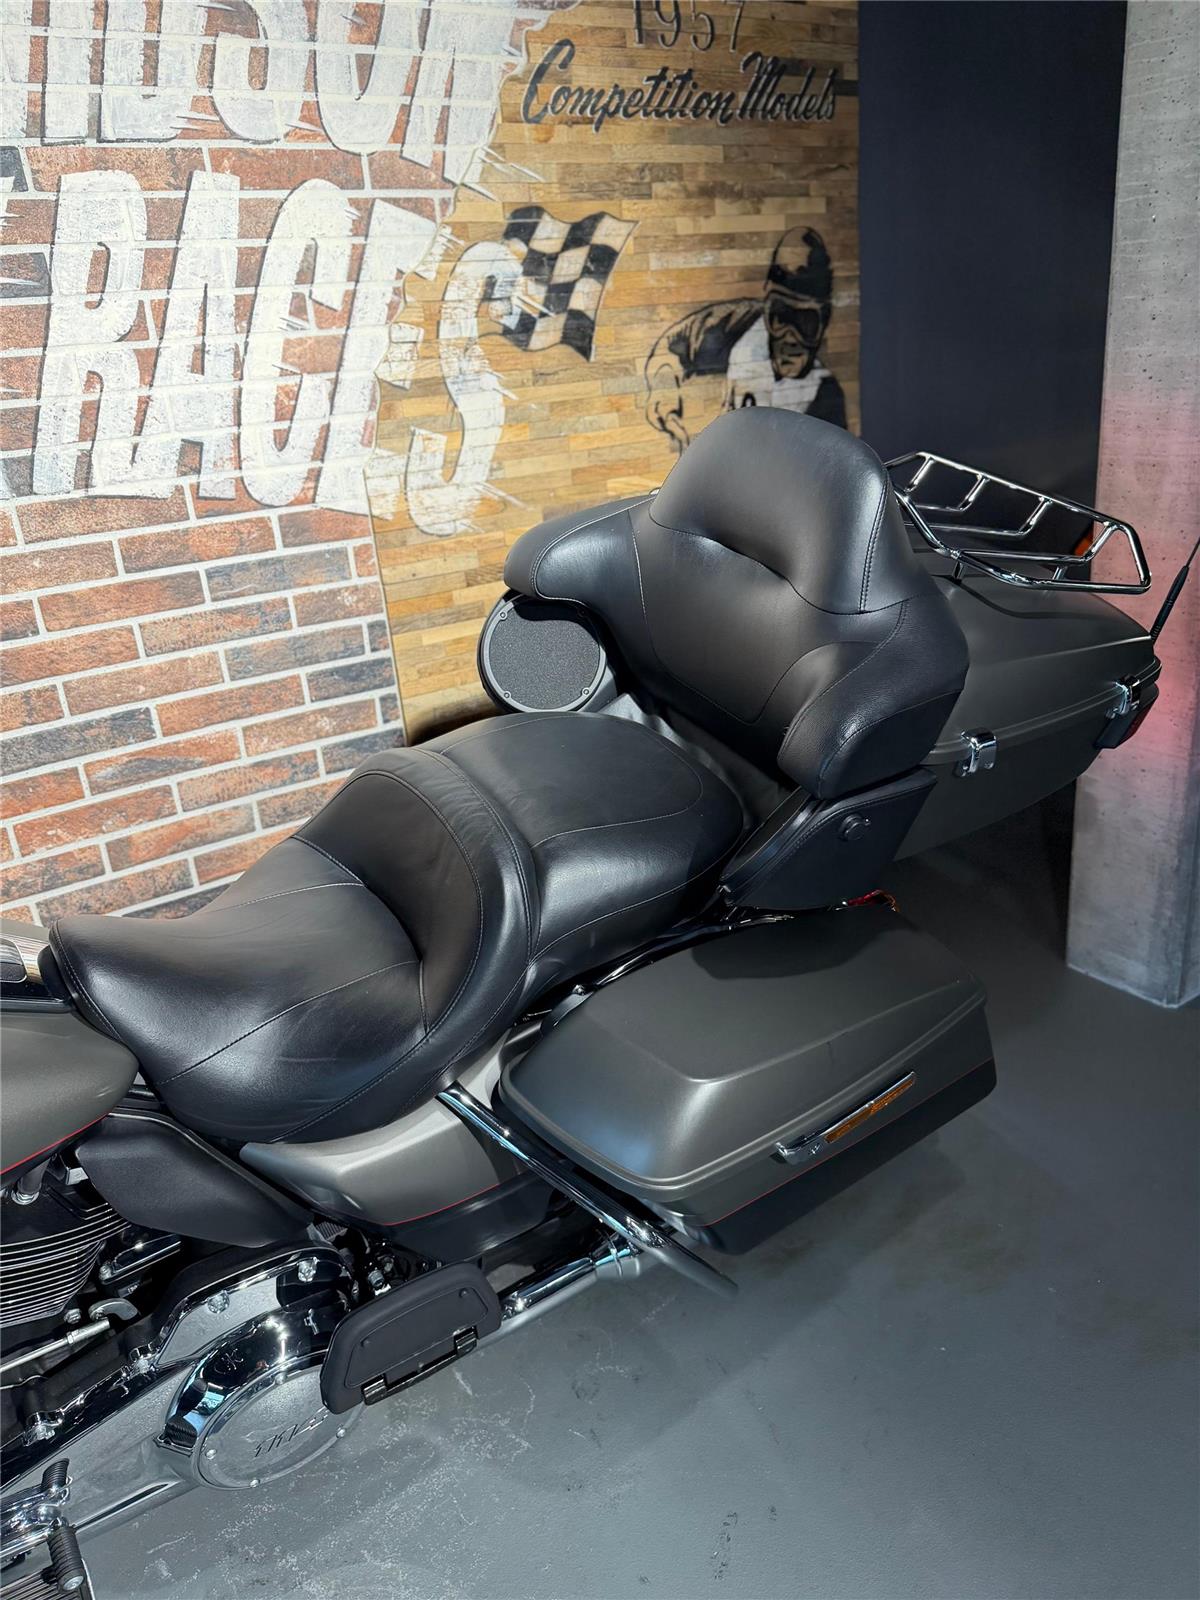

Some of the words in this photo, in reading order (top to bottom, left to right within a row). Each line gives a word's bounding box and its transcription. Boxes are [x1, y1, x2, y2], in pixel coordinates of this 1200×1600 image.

[632, 0, 746, 53] 1957
[521, 38, 734, 133] Competition
[740, 51, 837, 121] Models
